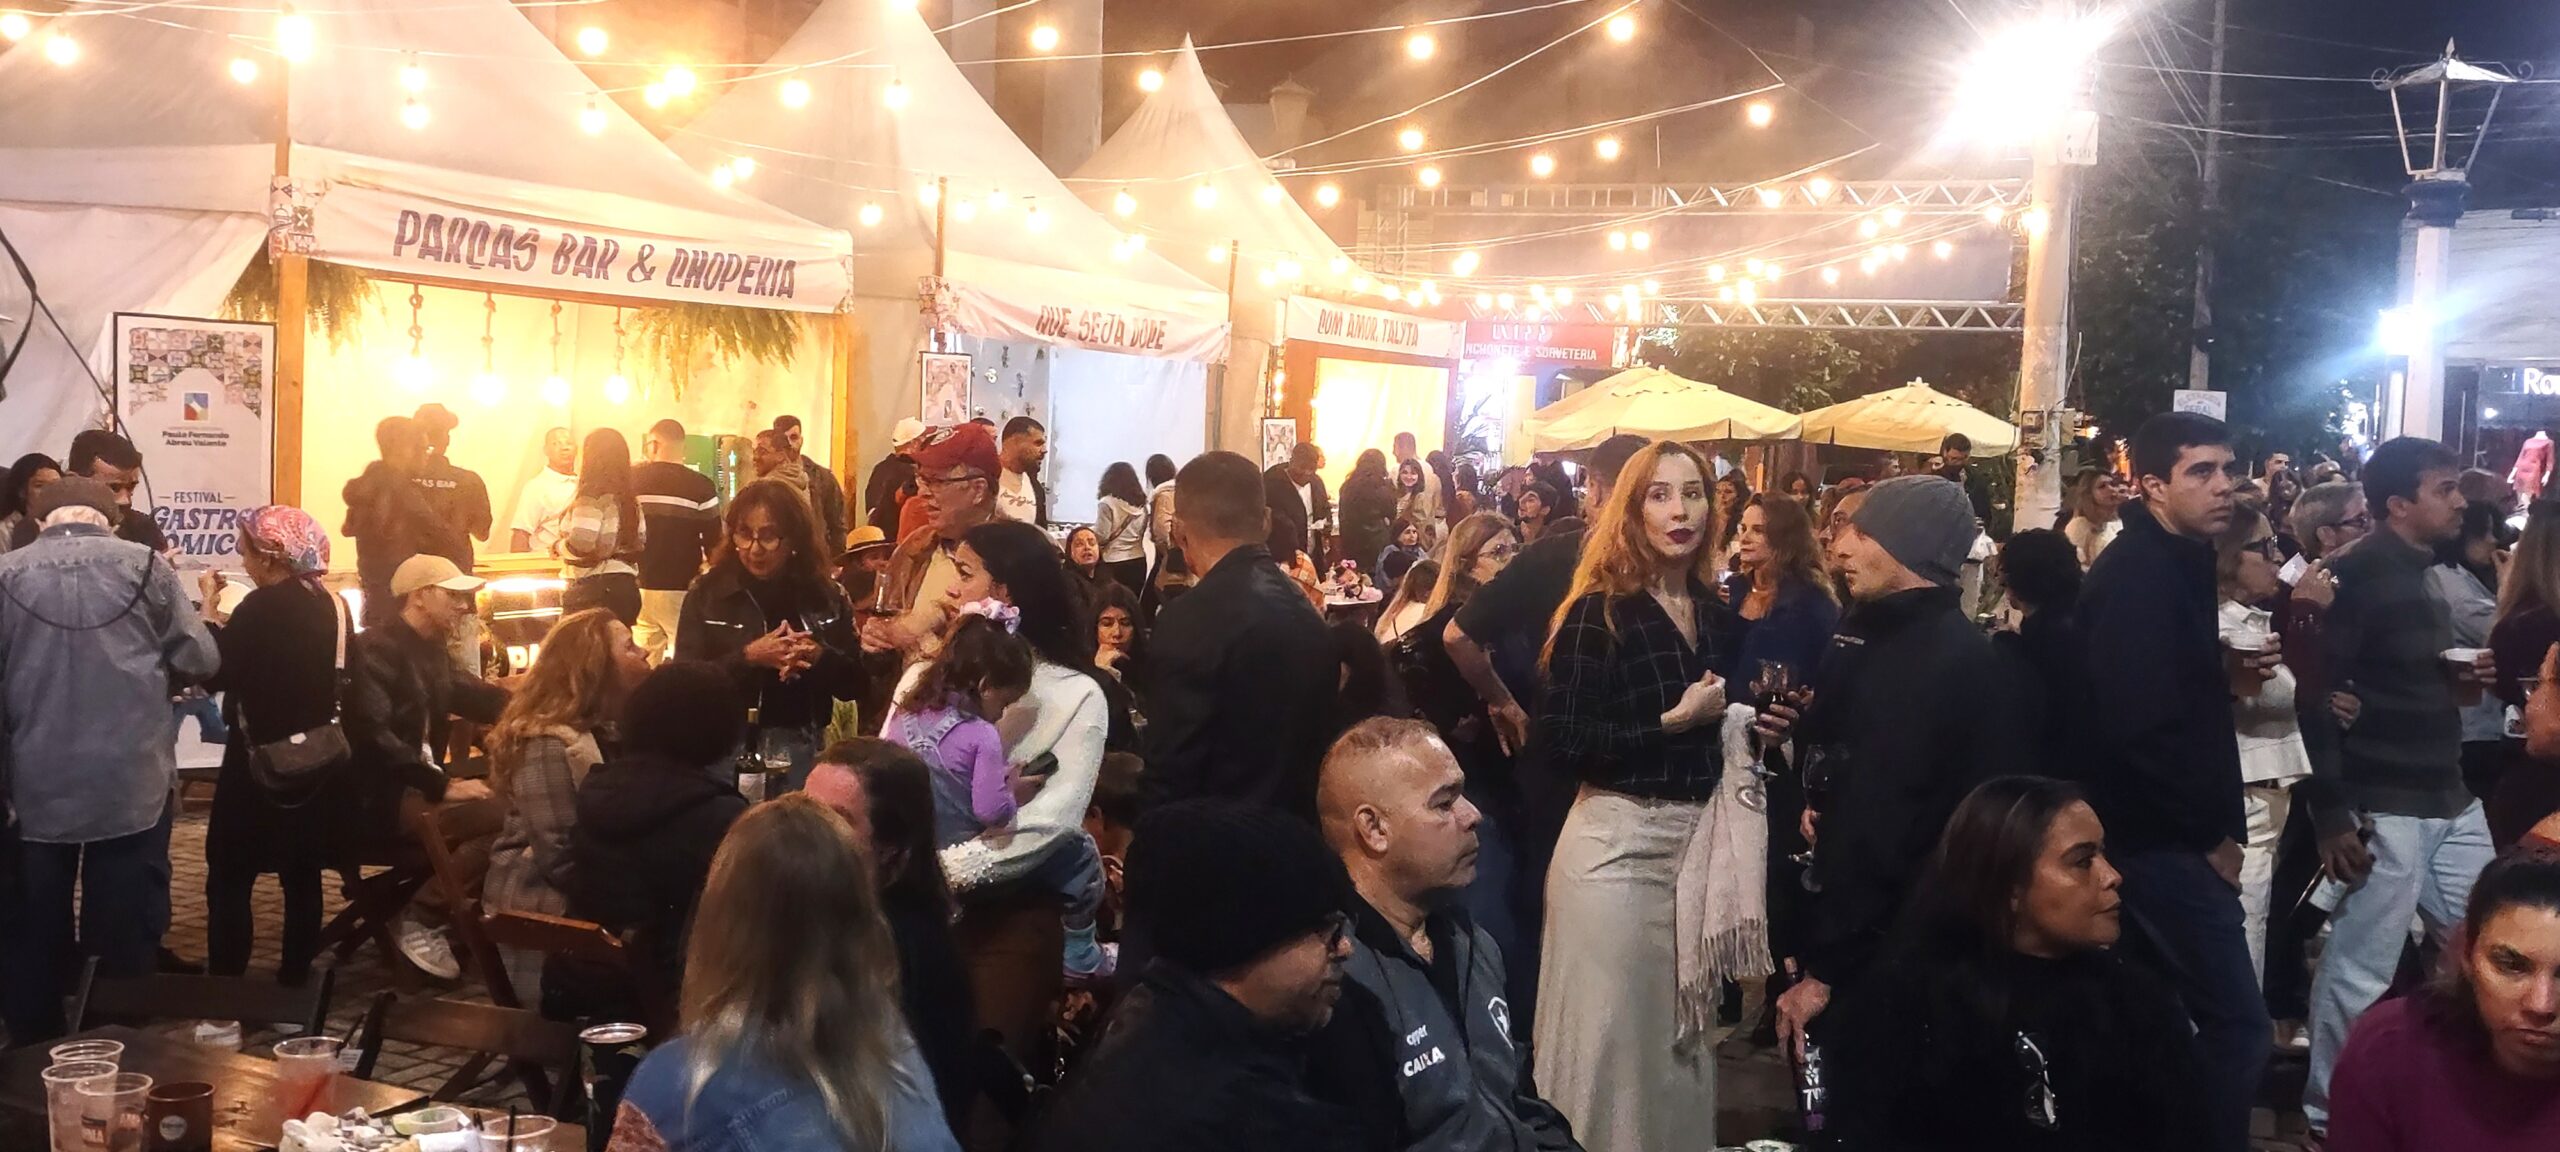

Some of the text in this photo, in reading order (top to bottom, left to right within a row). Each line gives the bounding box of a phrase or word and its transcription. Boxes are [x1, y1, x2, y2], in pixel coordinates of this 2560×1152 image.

[393, 208, 798, 299] PARÇAS BAR & CHOPERIA
[1035, 305, 1072, 338] QUE
[1078, 310, 1126, 347] SEJA
[1381, 318, 1419, 347] TALYTA
[1535, 347, 1597, 361] SORVETERIA
[173, 491, 224, 504] FESTIVAL
[1403, 1046, 1446, 1077] CAIXA
